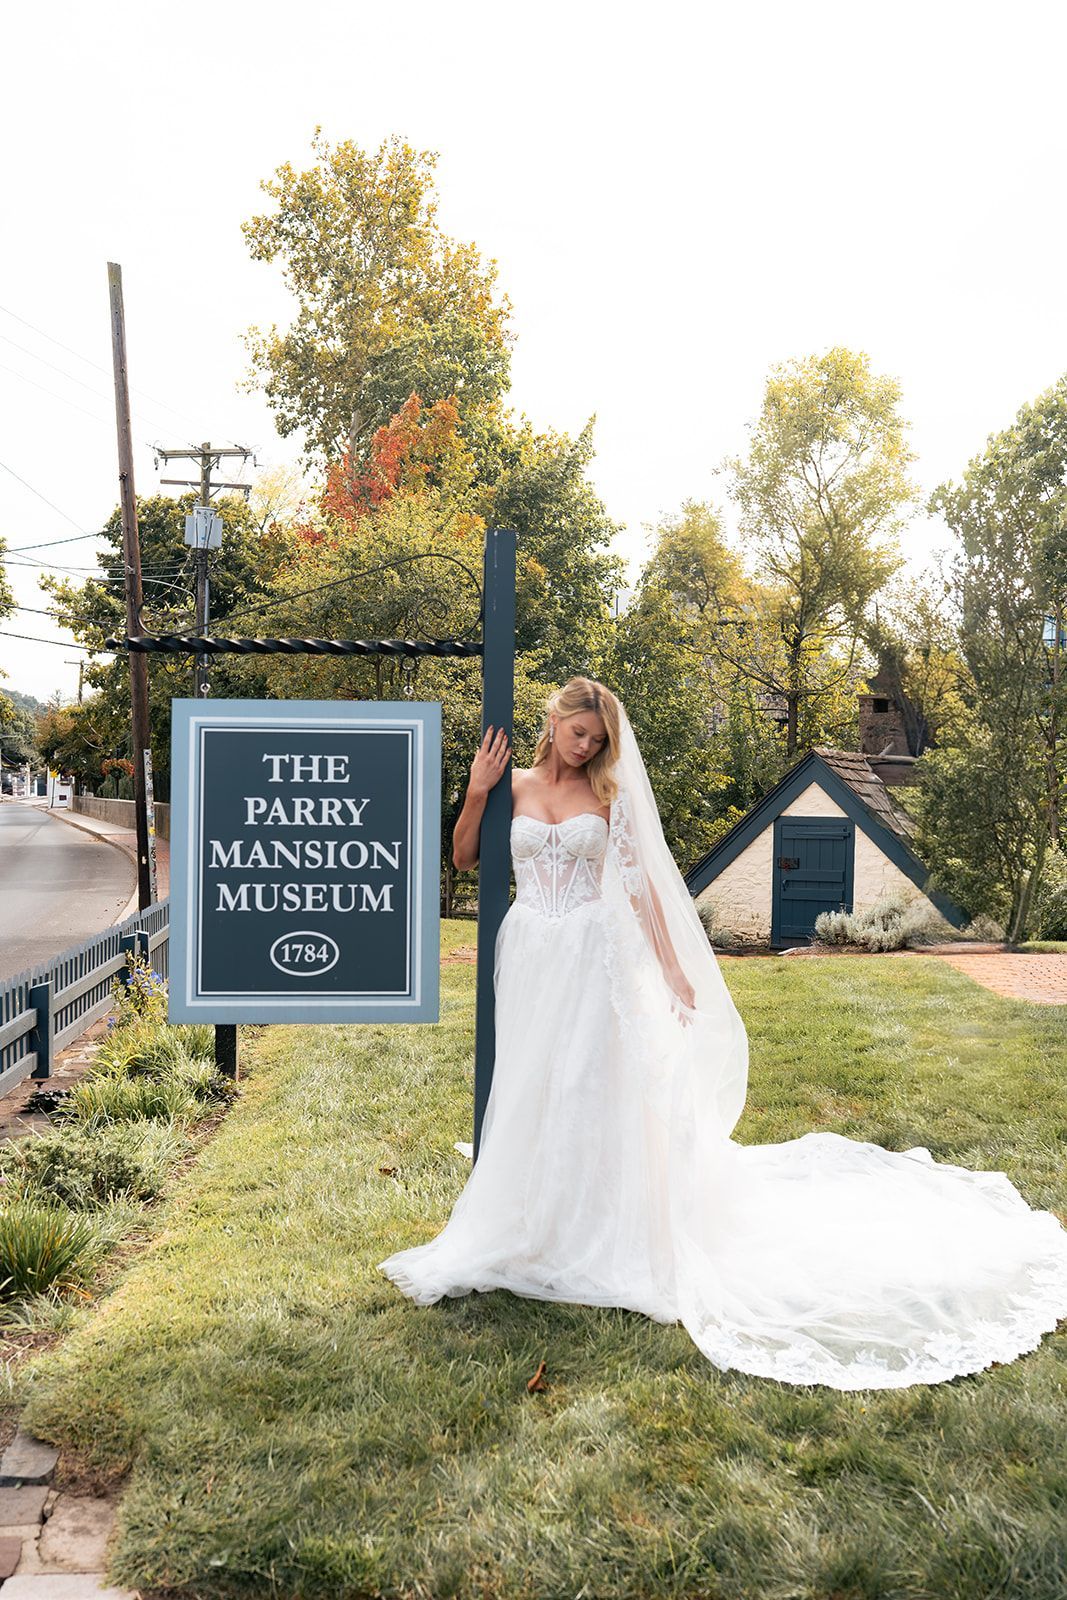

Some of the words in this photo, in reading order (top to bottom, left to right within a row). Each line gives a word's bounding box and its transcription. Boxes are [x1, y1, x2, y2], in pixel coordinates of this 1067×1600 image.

[262, 753, 350, 783] THE
[243, 797, 371, 826] PARRY
[208, 840, 402, 869] MANSION
[215, 883, 394, 912] MUSEUM
[280, 943, 329, 963] 1784
